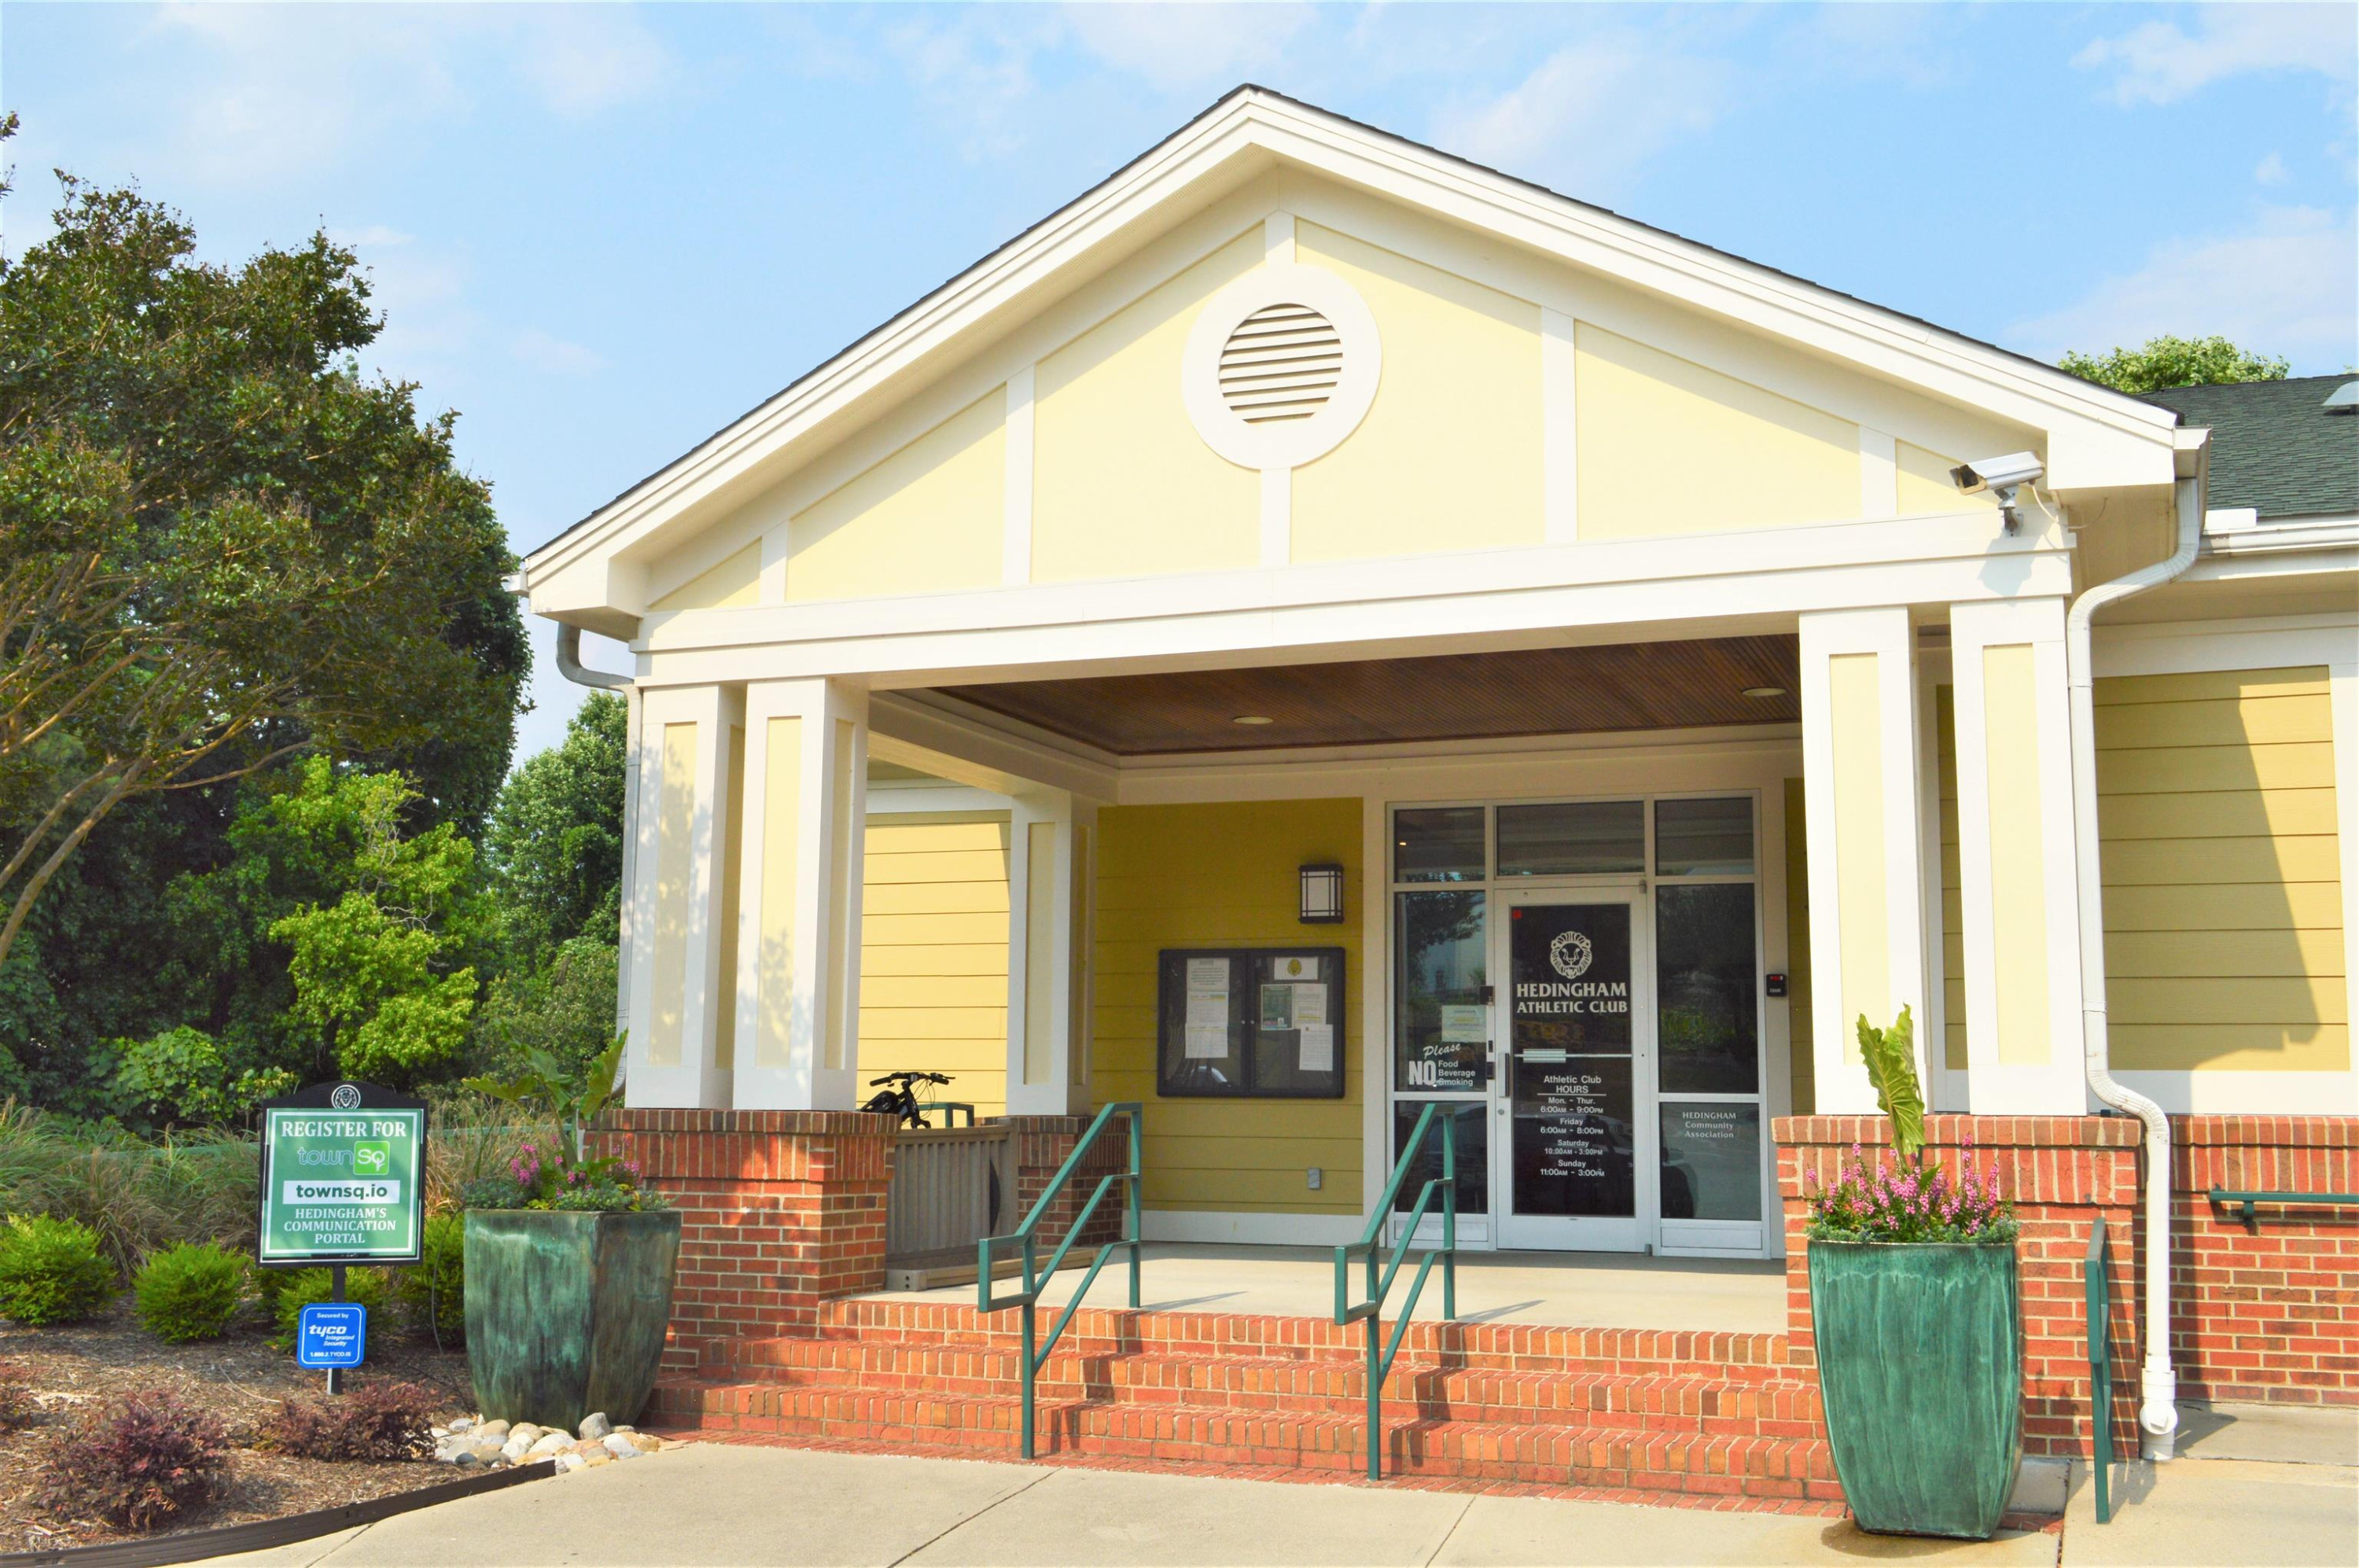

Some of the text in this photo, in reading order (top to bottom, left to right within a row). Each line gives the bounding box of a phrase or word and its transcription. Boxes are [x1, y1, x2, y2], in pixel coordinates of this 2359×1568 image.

[1517, 982, 1627, 997] HEDINGHAM
[1517, 1000, 1628, 1014] ATHLETIC CLUB
[1422, 1043, 1461, 1059] Please
[1408, 1060, 1437, 1085] NO
[1438, 1078, 1474, 1087] Smoking
[1544, 1075, 1602, 1084] Athletic Club
[1555, 1085, 1589, 1094] HOURS
[1682, 1111, 1736, 1120] HEDINGHAM
[1559, 1117, 1584, 1126] Friday
[1684, 1121, 1734, 1130] Community
[281, 1121, 407, 1137] REGISTER FOR
[1557, 1139, 1590, 1148] Saturday
[1558, 1159, 1587, 1169] Sunday
[296, 1183, 388, 1200] townsq.io
[295, 1207, 388, 1219] HEDINGHAM'S
[284, 1220, 396, 1231] COMMUNICATION
[315, 1233, 366, 1244] PORTAL
[308, 1324, 347, 1337] tyco
